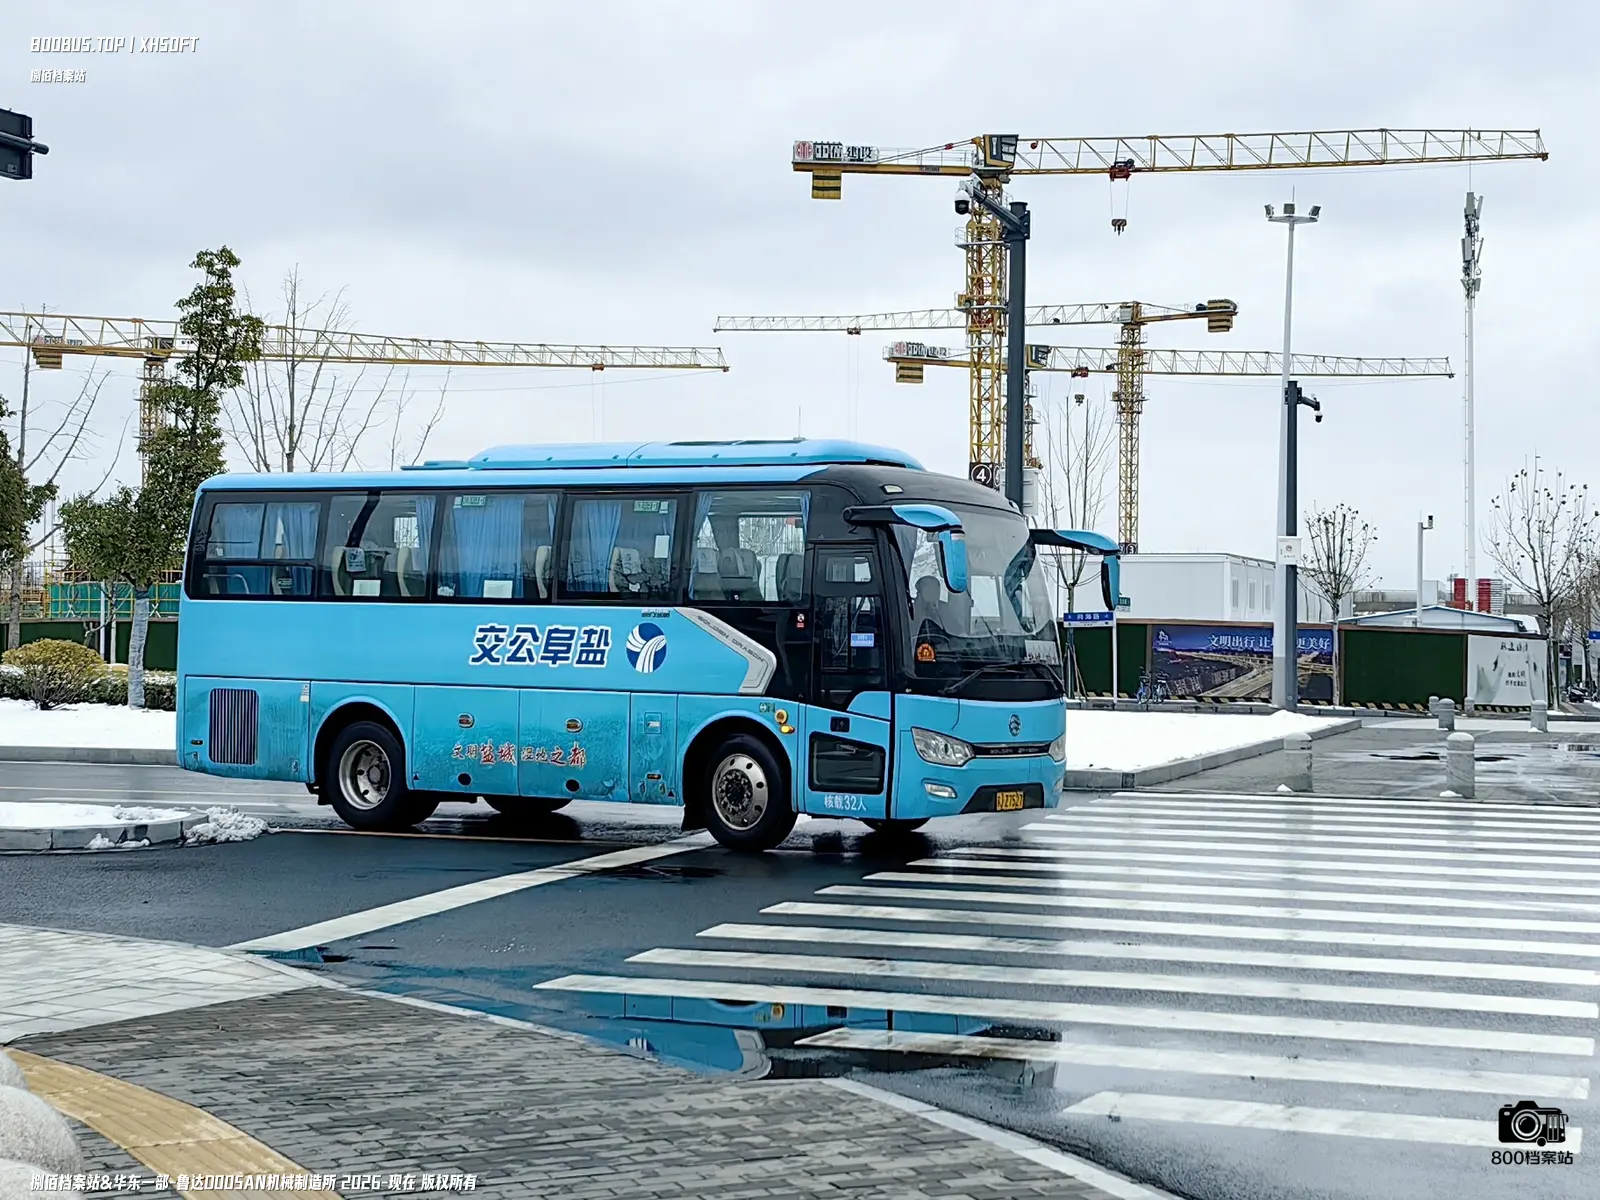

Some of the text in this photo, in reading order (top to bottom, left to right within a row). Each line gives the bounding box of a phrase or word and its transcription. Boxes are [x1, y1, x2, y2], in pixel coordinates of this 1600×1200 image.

[1208, 634, 1254, 648] 文明出行
[824, 794, 867, 811] 核载32人
